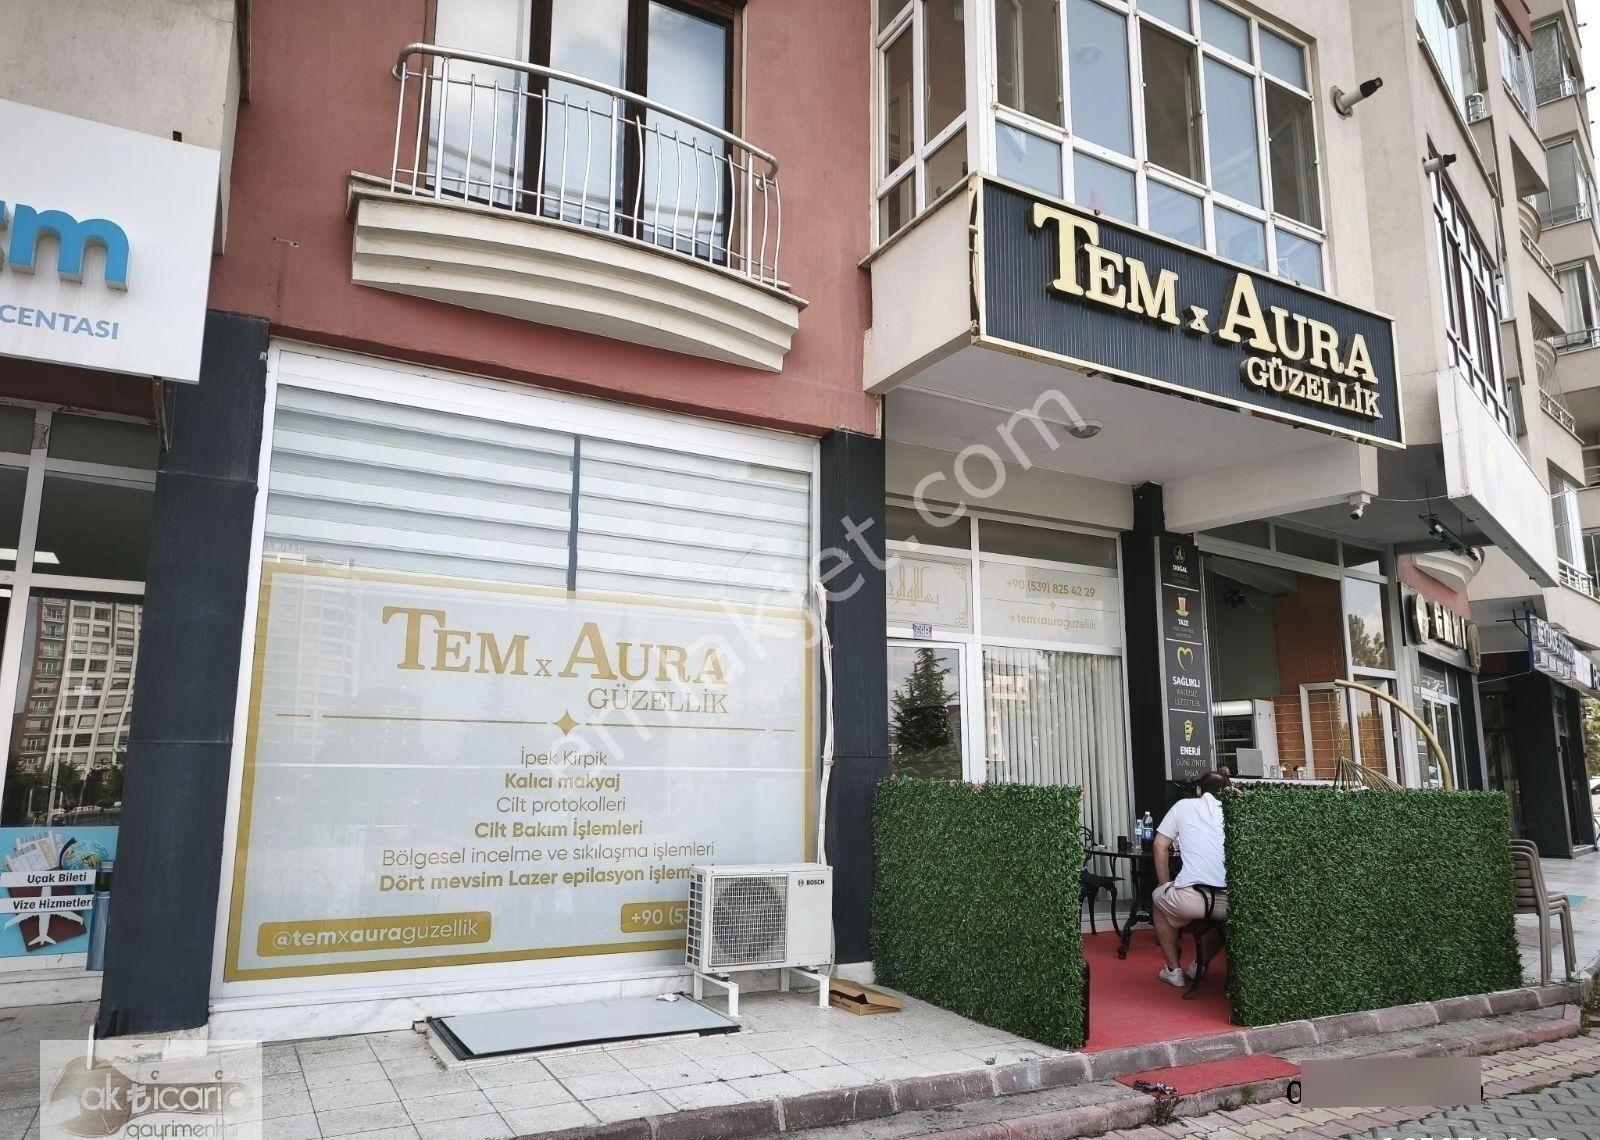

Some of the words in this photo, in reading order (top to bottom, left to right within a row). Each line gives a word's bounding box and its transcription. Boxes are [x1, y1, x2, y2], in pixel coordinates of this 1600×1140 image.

[0, 198, 129, 290] m
[1029, 201, 1181, 327] TEM
[1213, 271, 1380, 386] AURA
[0, 303, 119, 340] CENTASI
[1242, 355, 1384, 421] GÜZELLİK
[1006, 578, 1025, 590] +90
[1027, 580, 1051, 594] (539)
[1052, 583, 1069, 596] 825
[1071, 585, 1083, 597] 42
[1084, 587, 1095, 598] 29
[915, 626, 931, 637] 69B
[381, 605, 531, 677] TEM
[557, 621, 729, 685] AURA
[1172, 676, 1201, 688] SAĞLIKLI
[587, 683, 730, 714] GÜZELLİK
[520, 746, 558, 769] İpek
[563, 750, 608, 769] Kirpik
[1180, 745, 1201, 756] ENERJİ
[504, 772, 552, 789] Kalıcı
[558, 773, 621, 792] makyaj
[496, 796, 528, 814] Cilt
[532, 796, 626, 816] protokolleri
[474, 821, 507, 839] Cilt
[512, 821, 568, 838] Bakım
[572, 817, 643, 840] İşlemleri
[382, 847, 466, 870] Bölgesel
[471, 845, 543, 864] incelme
[548, 848, 568, 861] ve
[572, 843, 648, 863] sıkılaşma
[653, 841, 715, 861] işlemleri
[27, 873, 56, 885] Uçak
[58, 872, 87, 883] Bileti
[379, 874, 425, 892] Dört
[430, 871, 503, 890] mevsim
[508, 870, 558, 886] Lazer
[562, 866, 645, 888] epilasyon
[649, 864, 690, 885] işlem
[13, 899, 36, 910] Vize
[38, 898, 92, 909] Hizmetler
[631, 908, 663, 925] +90
[272, 918, 479, 950] @temxauraguzellik
